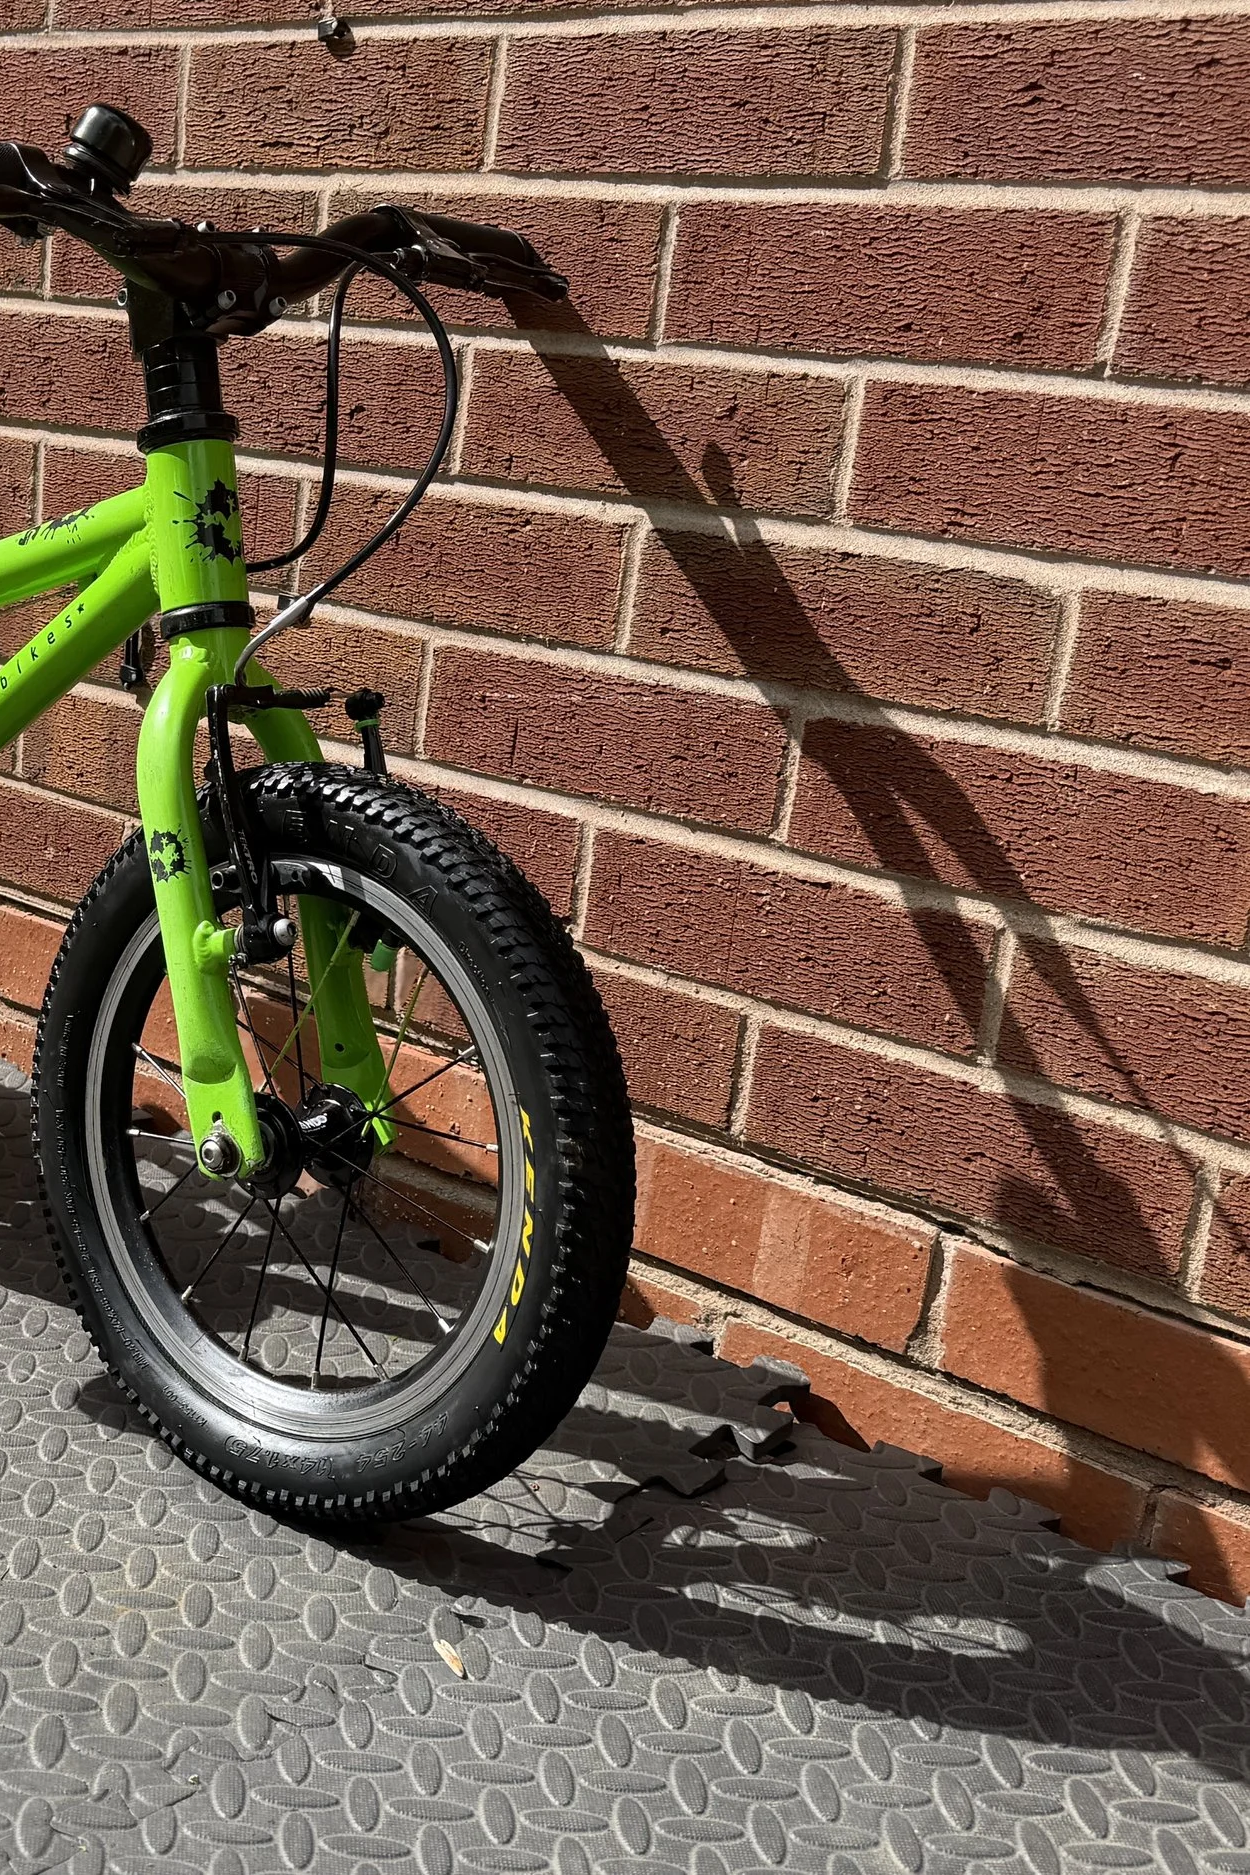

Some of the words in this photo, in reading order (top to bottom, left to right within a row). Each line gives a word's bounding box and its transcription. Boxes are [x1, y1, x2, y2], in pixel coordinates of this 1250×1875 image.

[0, 617, 72, 690] bikes
[298, 1114, 327, 1130] ANDO
[493, 1105, 535, 1345] KENDA
[355, 1411, 450, 1474] 44-254
